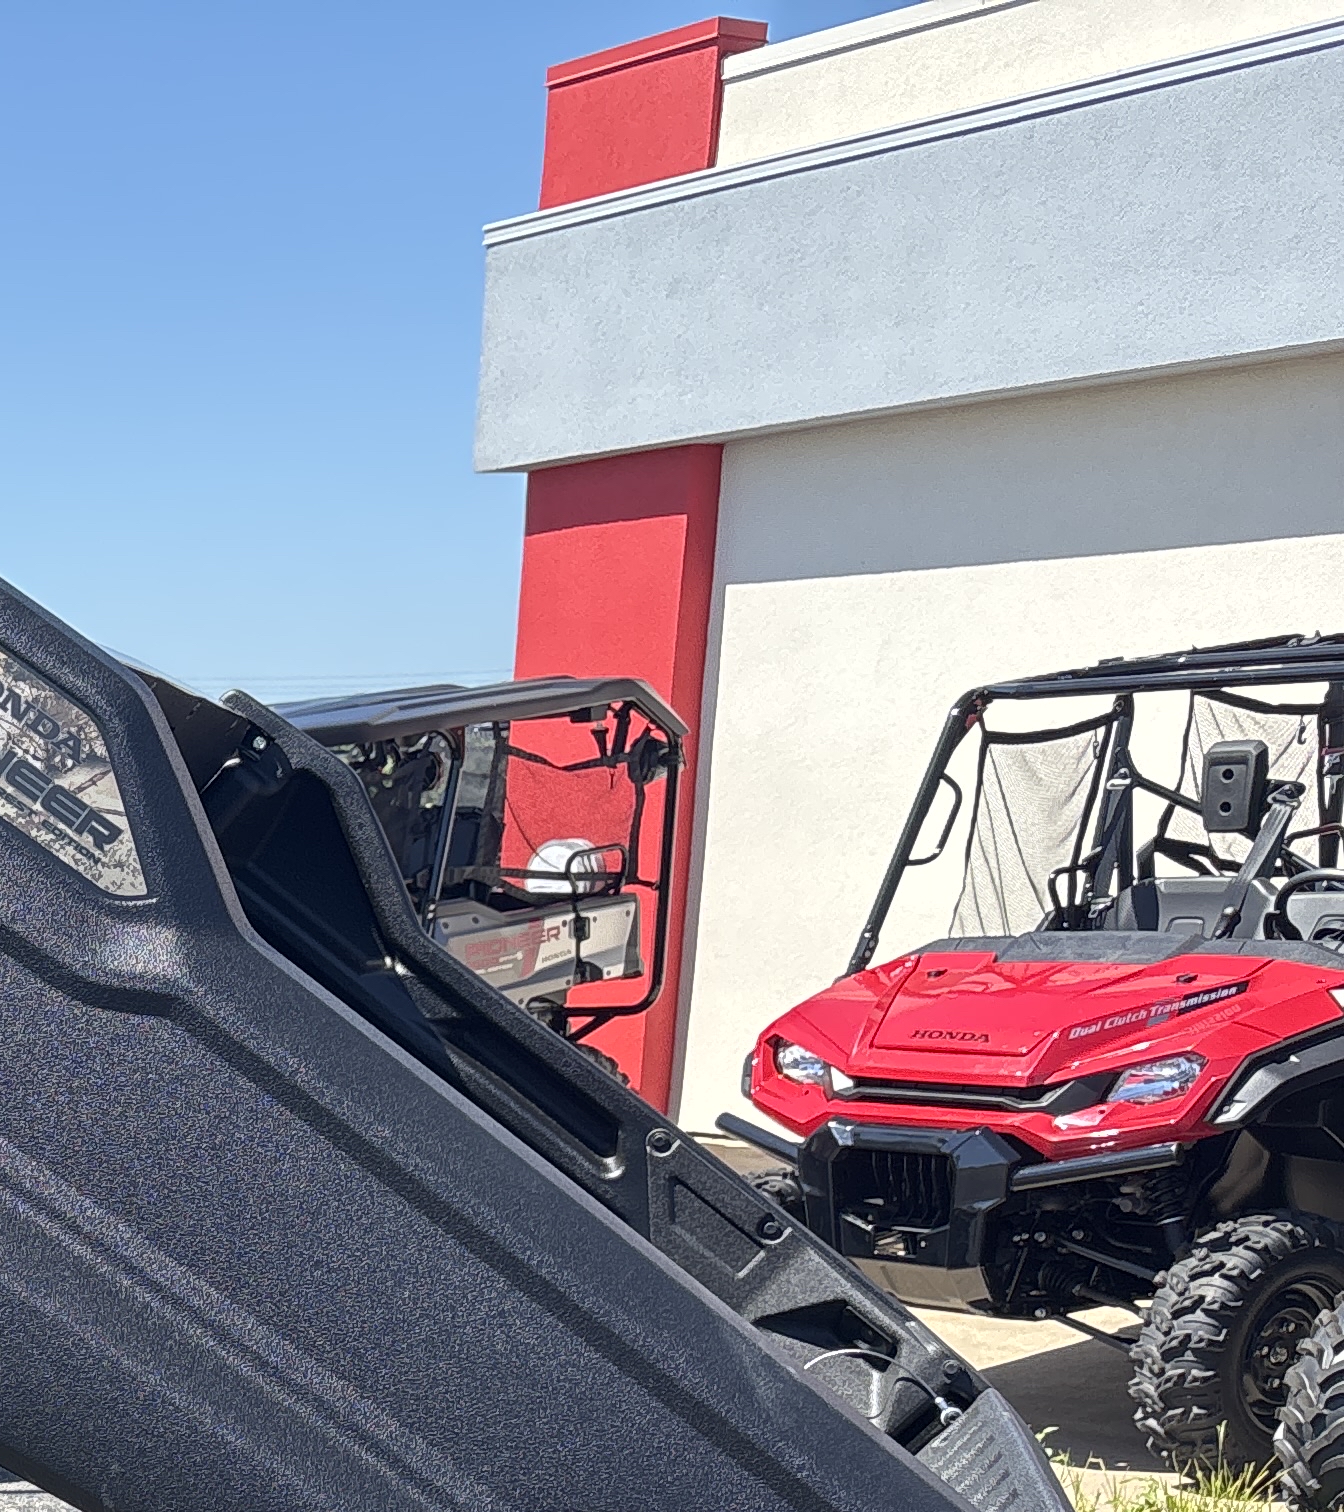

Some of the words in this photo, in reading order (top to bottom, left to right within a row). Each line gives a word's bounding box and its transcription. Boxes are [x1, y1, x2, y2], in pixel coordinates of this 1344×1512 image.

[41, 819, 101, 866] EDITION
[911, 1030, 990, 1043] HONDA
[1067, 1021, 1101, 1040] Dual
[1103, 1008, 1148, 1031] Clutch
[1149, 986, 1238, 1018] Transmission
